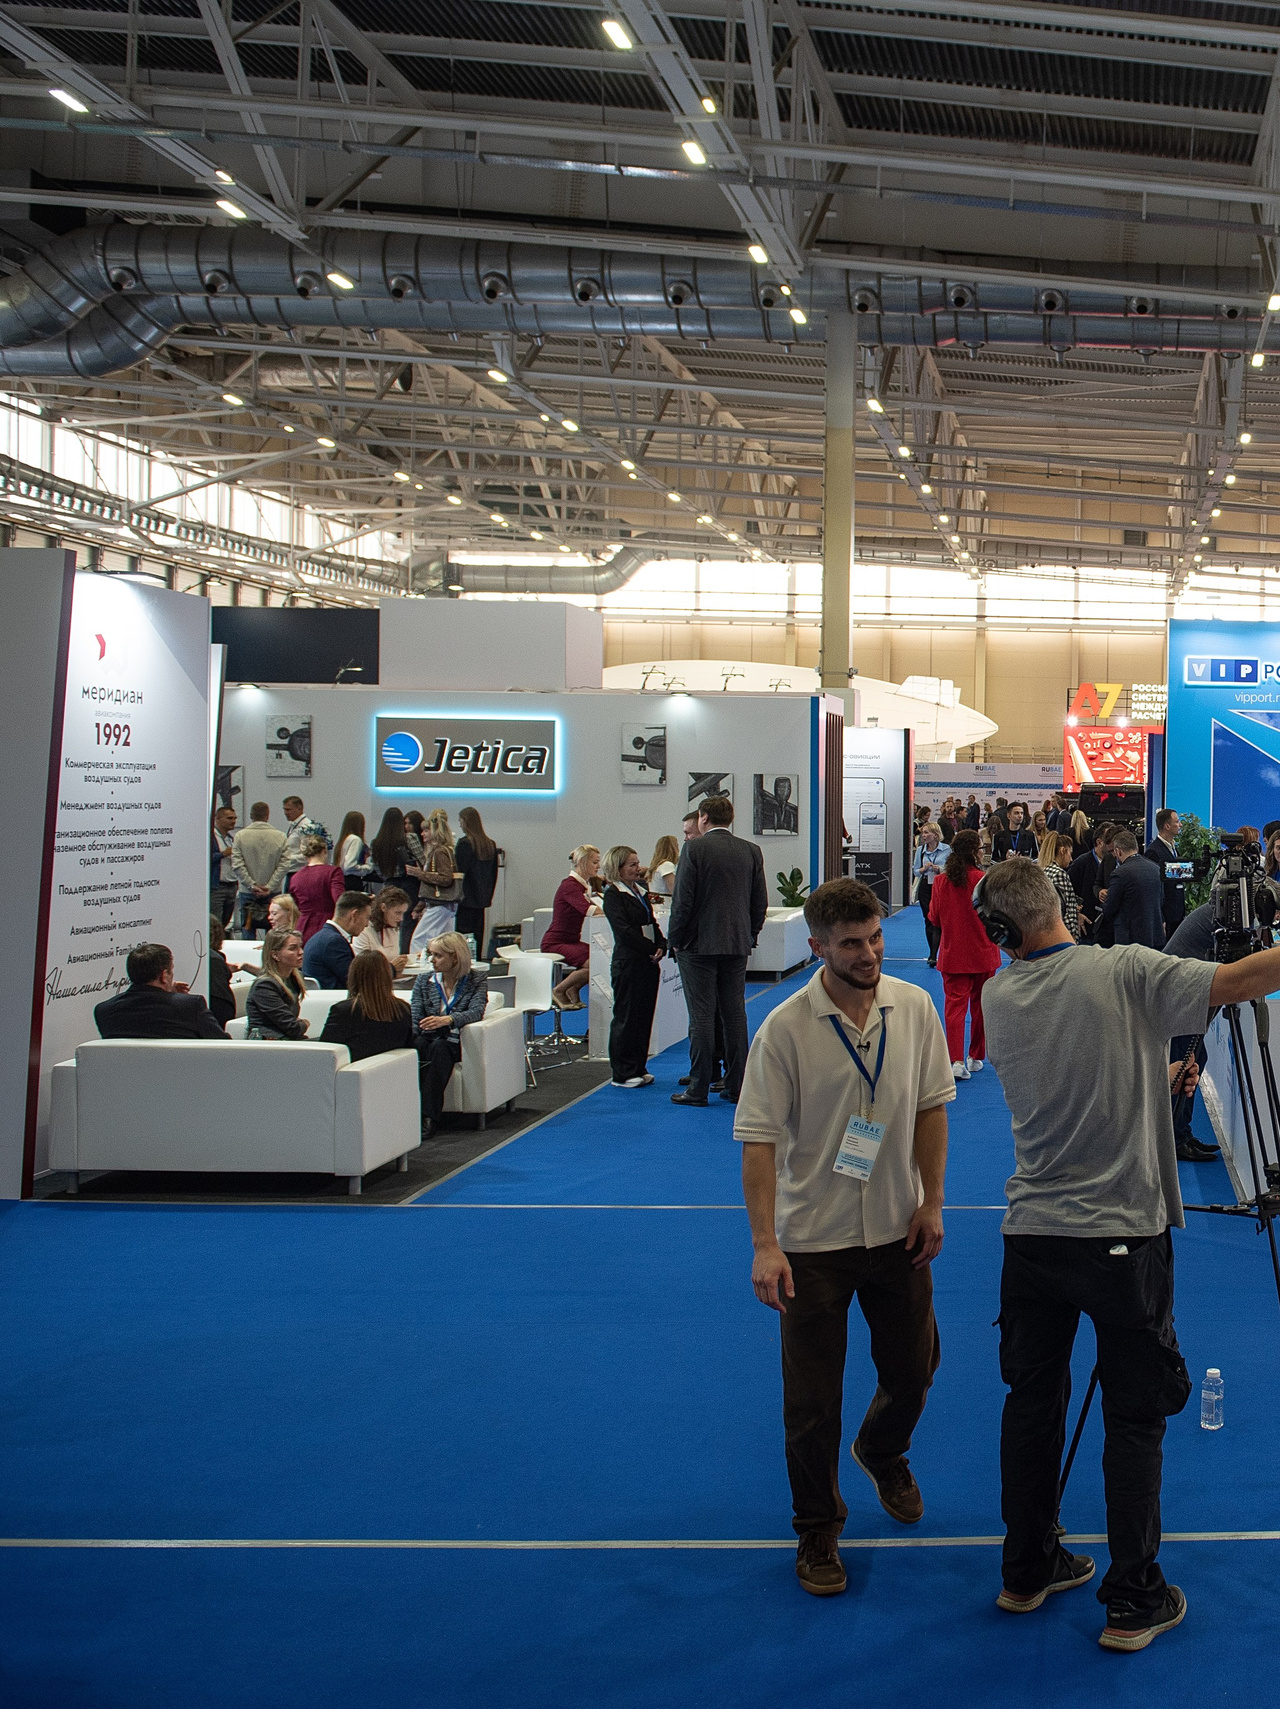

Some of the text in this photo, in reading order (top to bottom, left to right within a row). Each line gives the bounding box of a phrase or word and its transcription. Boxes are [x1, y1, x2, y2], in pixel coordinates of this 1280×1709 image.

[1192, 664, 1252, 678] VIP
[81, 685, 143, 705] меридиан
[95, 723, 131, 747] 1992
[424, 738, 549, 775] Jetica
[65, 757, 156, 772] Коммерческая эксплуатация
[84, 774, 141, 785] воздушных судов
[60, 800, 161, 812] Менеджмент воздушных судов
[108, 826, 148, 837] обеспечение
[150, 827, 173, 836] полетов
[88, 840, 135, 853] обслуживание
[137, 840, 171, 850] воздушных
[79, 857, 99, 868] судов
[106, 854, 144, 865] пассажиров
[59, 879, 160, 896] Поддержание летной годности
[83, 893, 141, 907] воздушных судов
[70, 918, 152, 936] Авиационный консалтинг
[67, 947, 114, 964] Авиационный
[853, 1121, 881, 1135] RUBAE
